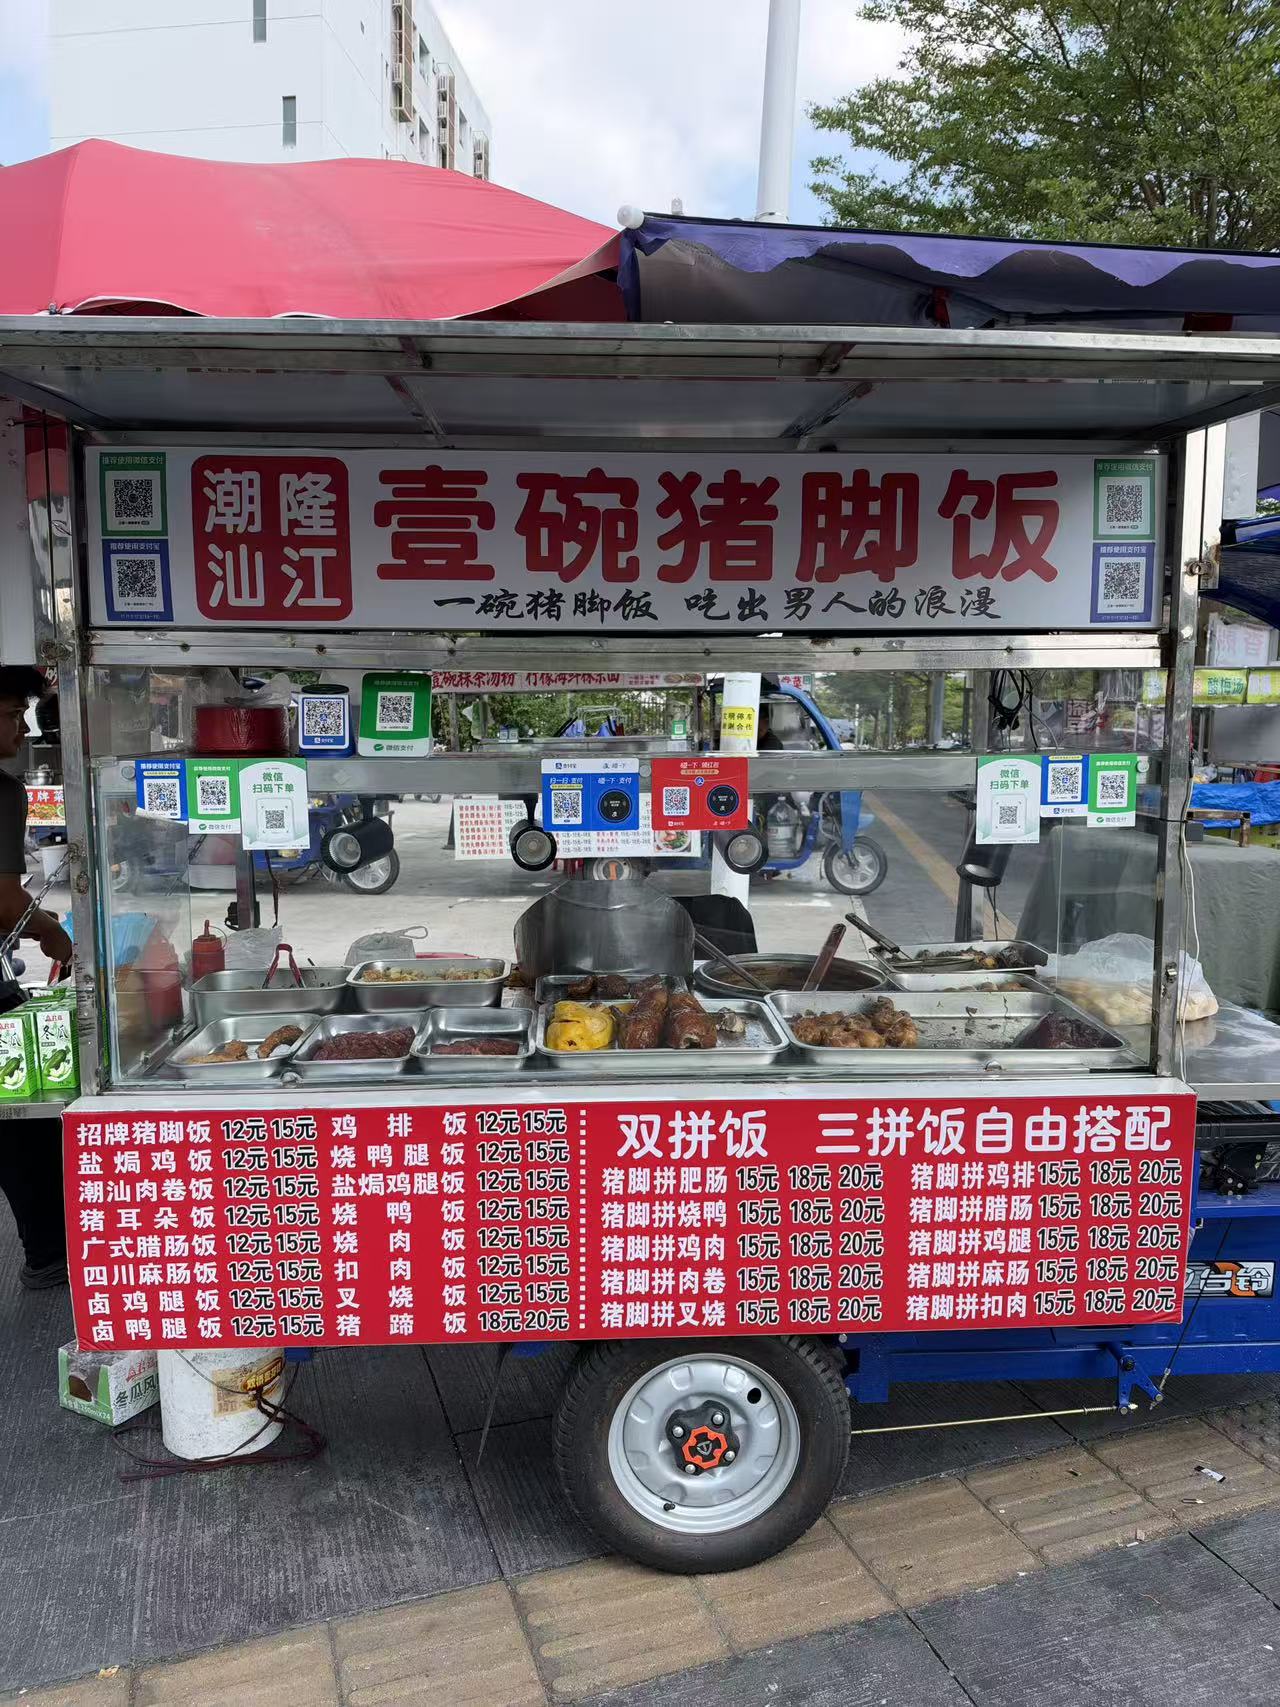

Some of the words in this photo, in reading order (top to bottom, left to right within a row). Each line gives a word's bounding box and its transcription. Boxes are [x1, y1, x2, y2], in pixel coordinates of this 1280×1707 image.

[374, 464, 1059, 583] 壹碗猪脚饭
[433, 587, 659, 624] 一碗猪脚饭
[683, 585, 1002, 623] 吃出男人的浪漫
[262, 772, 284, 782] 微信
[990, 780, 1029, 790] 扫码下单
[1000, 769, 1020, 778] 微信
[252, 783, 295, 794] 扫码下单
[41, 1024, 69, 1040] 冬瓜
[77, 1120, 212, 1147] 招牌猪脚饭
[221, 1118, 267, 1143] 12元
[271, 1116, 317, 1142] 15元
[476, 1109, 519, 1135] 12元
[523, 1109, 567, 1134] 15元
[616, 1109, 768, 1160] 双拼饭
[815, 1105, 1171, 1157] 三拼饭自由搭配
[222, 1146, 268, 1171] 12元
[272, 1145, 318, 1170] 15元
[477, 1140, 521, 1164] 12元
[525, 1140, 569, 1163] 15元
[79, 1177, 215, 1203] 潮汕肉卷饭
[223, 1175, 269, 1199] 12元
[273, 1174, 319, 1198] 15元
[331, 1171, 465, 1197] 盐焗鸡腿饭
[477, 1169, 521, 1192] 12元
[525, 1168, 569, 1192] 15元
[602, 1166, 728, 1195] 猪脚拼肥肠
[736, 1165, 779, 1191] 15元
[788, 1164, 830, 1191] 18元
[838, 1163, 883, 1190] 20元
[911, 1161, 1035, 1190] 猪脚拼鸡排
[1037, 1160, 1080, 1186] 15元
[1089, 1160, 1131, 1185] 18元
[1139, 1159, 1181, 1185] 20元
[225, 1203, 271, 1228] 12元
[274, 1202, 320, 1227] 15元
[477, 1198, 522, 1221] 12元
[525, 1197, 570, 1220] 15元
[601, 1200, 727, 1228] 猪脚拼烧鸭
[737, 1199, 780, 1225] 15元
[789, 1198, 832, 1224] 18元
[839, 1197, 884, 1223] 20元
[909, 1195, 1032, 1223] 猪脚拼腊肠
[1038, 1193, 1080, 1219] 15元
[1090, 1192, 1131, 1218] 18元
[1139, 1192, 1181, 1218] 20元
[82, 1234, 217, 1260] 广式腊肠饭
[226, 1232, 271, 1255] 12元
[275, 1231, 321, 1254] 15元
[477, 1226, 522, 1250] 12元
[525, 1225, 570, 1249] 15元
[601, 1234, 725, 1262] 猪脚拼鸡肉
[737, 1232, 780, 1259] 15元
[789, 1231, 831, 1257] 18元
[839, 1230, 884, 1256] 20元
[909, 1228, 1031, 1256] 猪脚拼鸡腿
[1037, 1226, 1079, 1251] 15元
[1089, 1225, 1130, 1250] 18元
[1138, 1224, 1181, 1249] 20元
[83, 1262, 219, 1287] 四川麻肠饭
[228, 1260, 273, 1282] 12元
[277, 1259, 322, 1282] 15元
[478, 1255, 522, 1277] 12元
[525, 1254, 570, 1276] 15元
[601, 1266, 726, 1295] 猪脚拼肉卷
[737, 1266, 780, 1292] 15元
[789, 1265, 830, 1291] 18元
[839, 1263, 883, 1289] 20元
[907, 1260, 1029, 1289] 猪脚拼麻肠
[1036, 1258, 1077, 1283] 15元
[1086, 1257, 1127, 1282] 18元
[1135, 1256, 1178, 1281] 20元
[229, 1287, 274, 1310] 12元
[278, 1286, 323, 1309] 15元
[478, 1282, 522, 1305] 12元
[525, 1282, 569, 1304] 15元
[906, 1292, 1027, 1320] 猪脚拼扣肉
[1034, 1290, 1075, 1315] 15元
[1084, 1289, 1125, 1314] 18元
[1132, 1288, 1175, 1312] 20元
[231, 1314, 275, 1338] 12元
[280, 1314, 324, 1337] 15元
[479, 1310, 522, 1332] 18元
[524, 1309, 569, 1332] 20元
[601, 1300, 726, 1328] 猪脚拼叉烧
[737, 1299, 779, 1325] 15元
[788, 1298, 830, 1323] 18元
[838, 1297, 881, 1322] 20元
[113, 1372, 159, 1410] 冬瓜风
